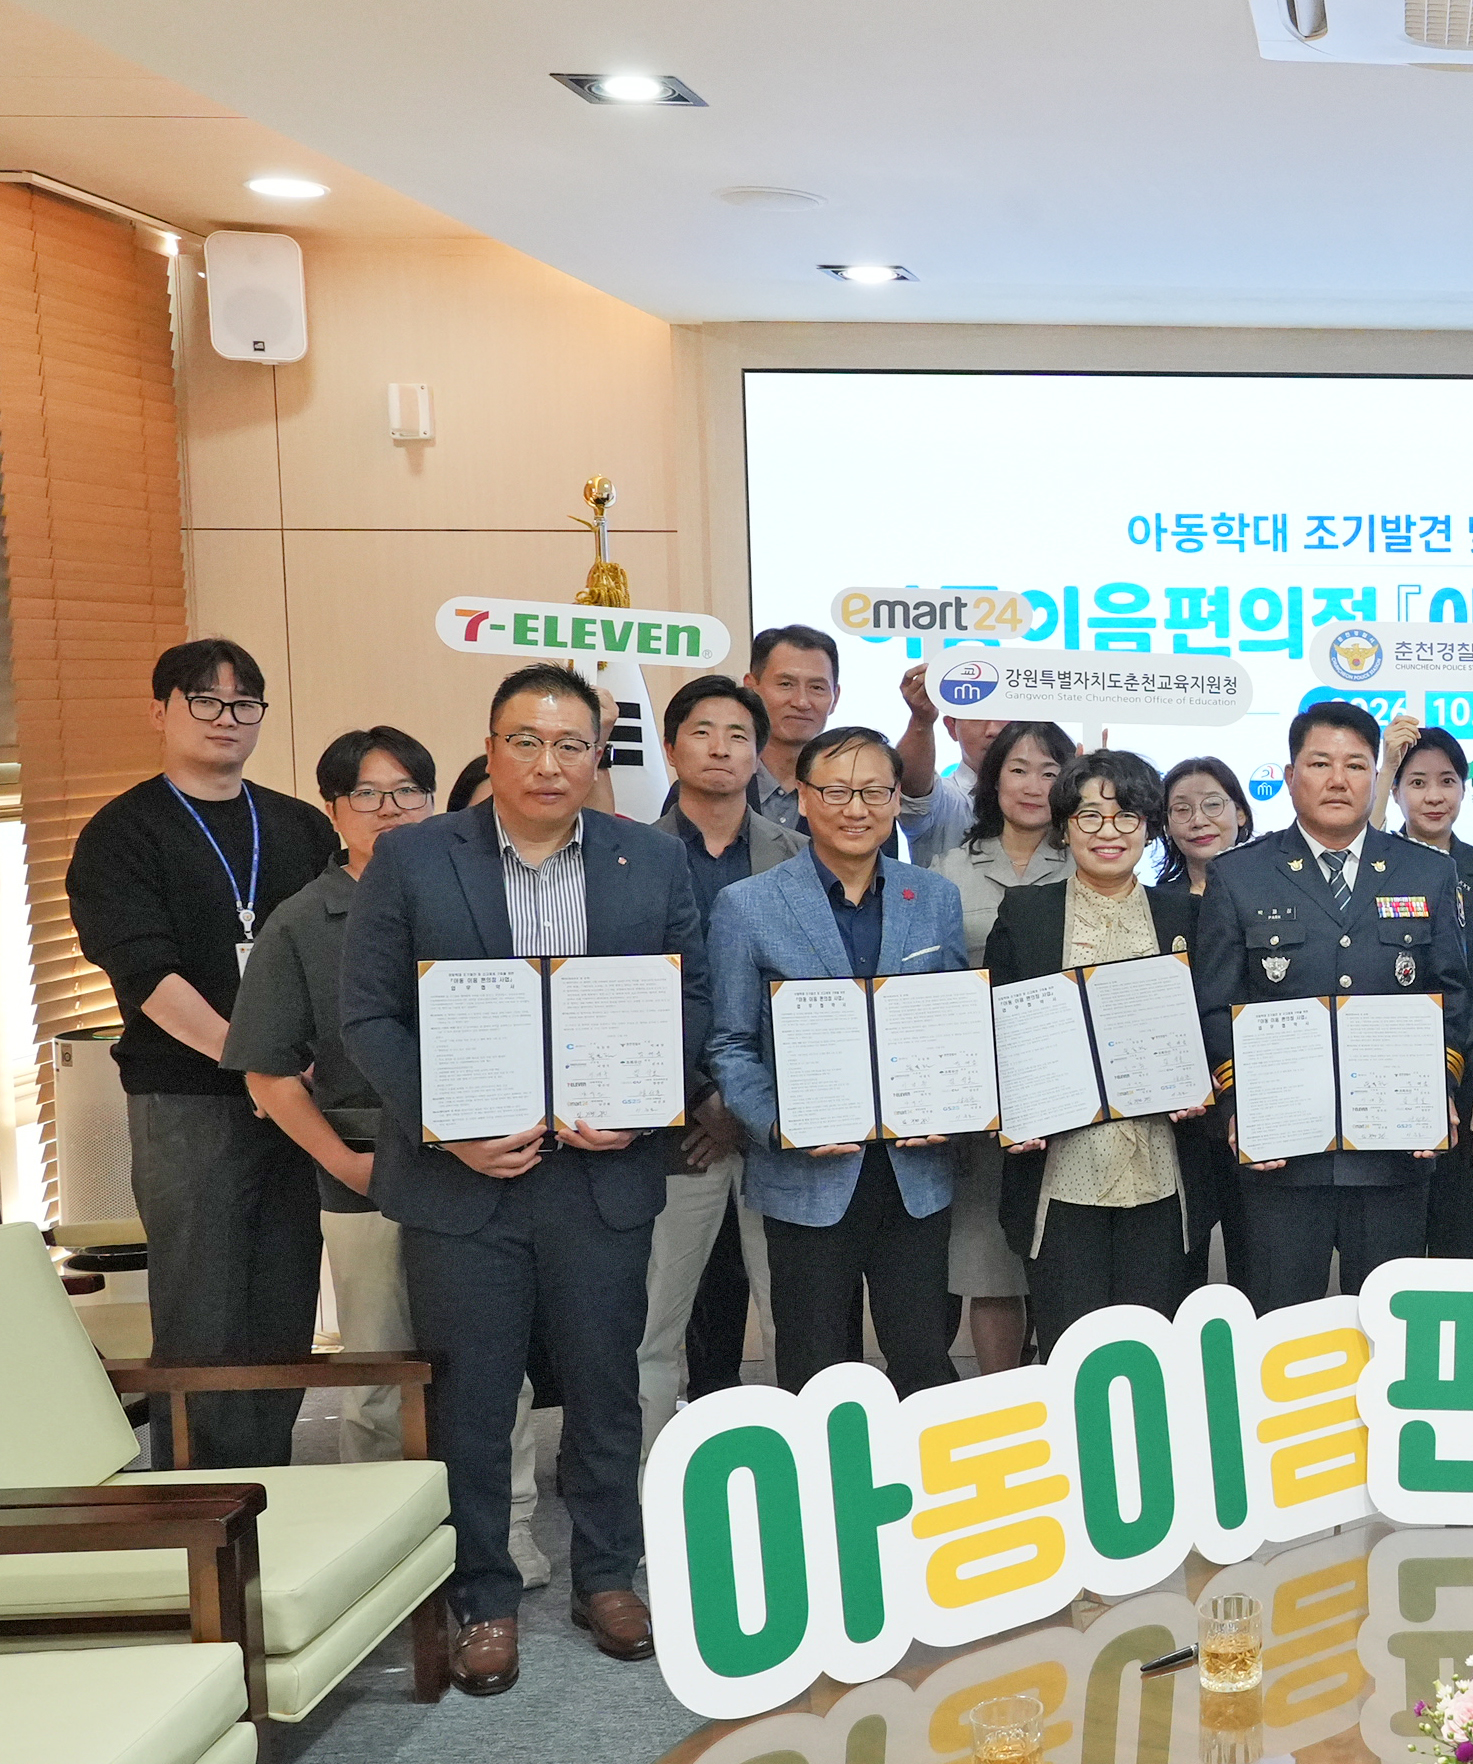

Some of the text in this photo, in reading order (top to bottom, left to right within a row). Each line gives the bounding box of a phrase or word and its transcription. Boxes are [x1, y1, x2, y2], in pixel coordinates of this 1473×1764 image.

[1126, 511, 1289, 554] 아동학대
[1303, 513, 1453, 554] 조기발견
[1395, 663, 1441, 671] CHUNCHEON
[1005, 668, 1238, 695] 강원특별자치도춘천교육지원청
[1005, 691, 1237, 707] Gangwon State Chuncheon Office of Education
